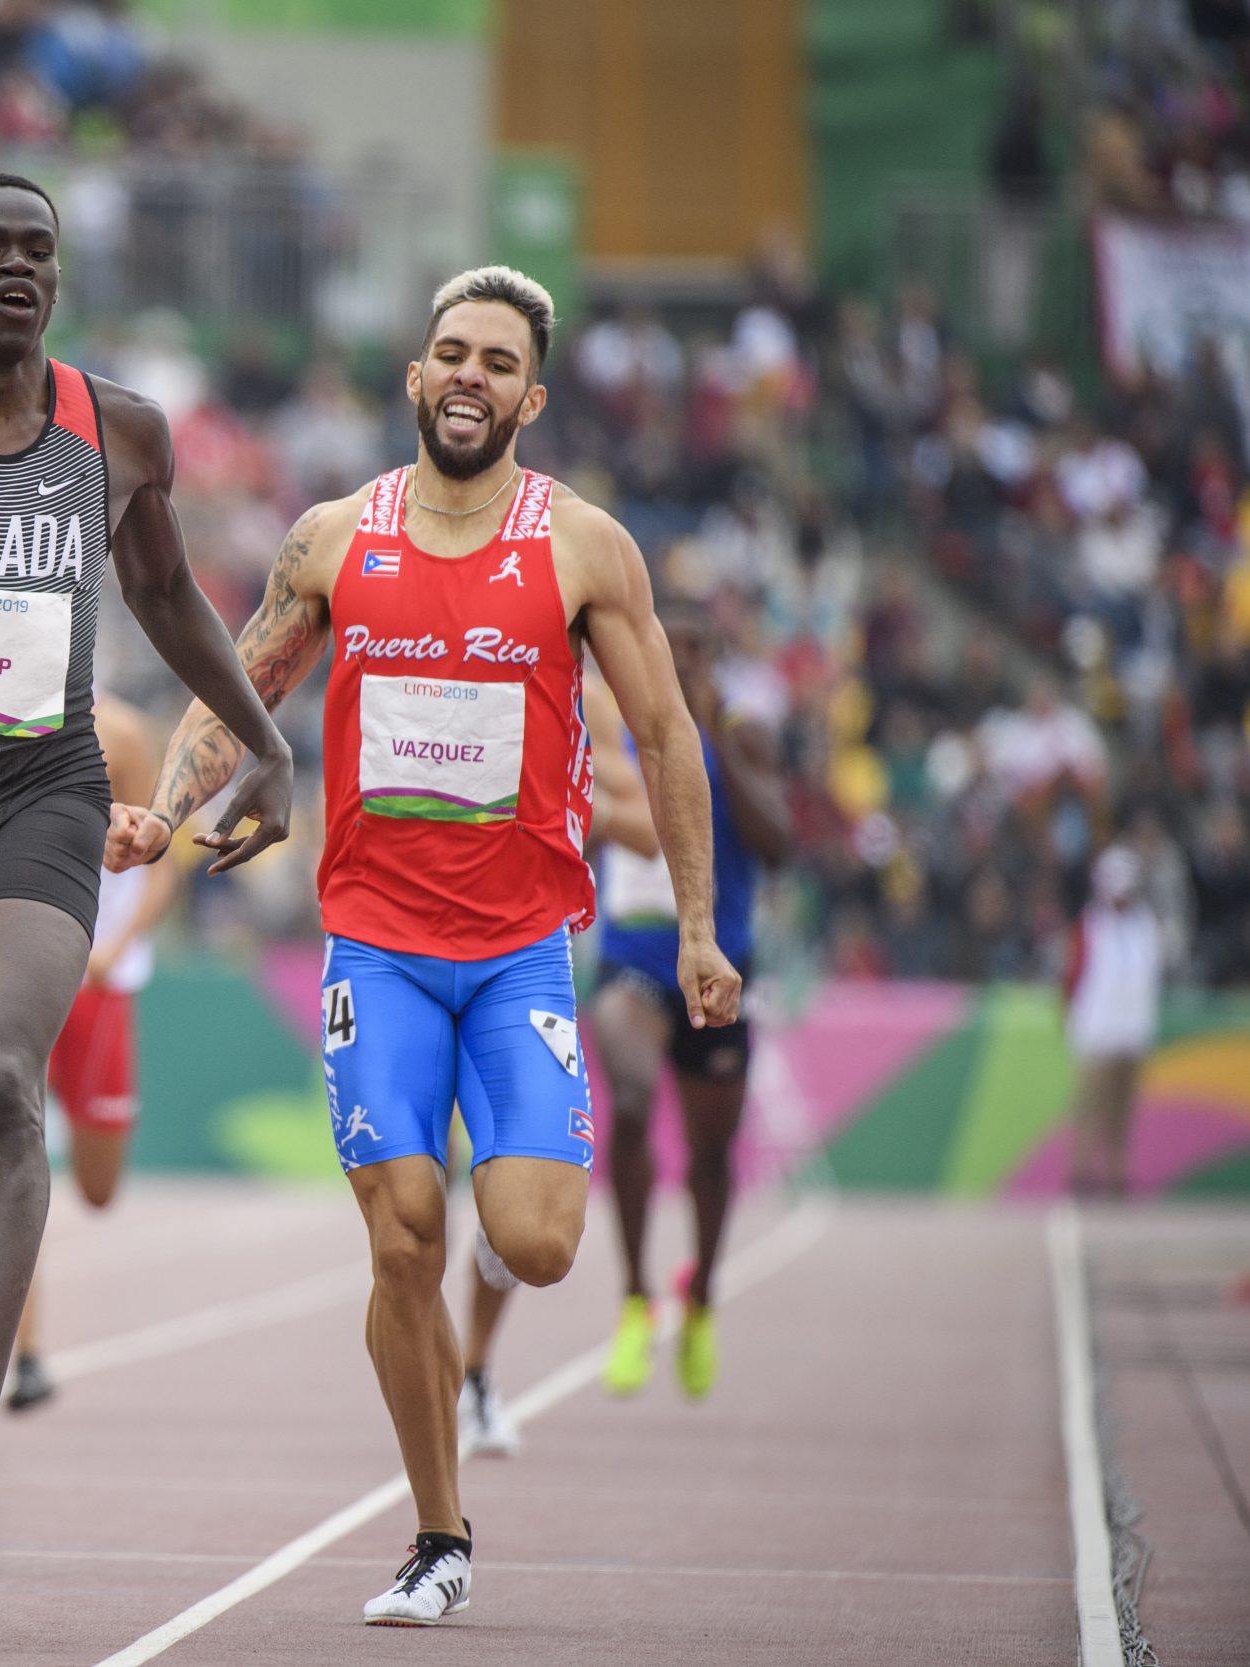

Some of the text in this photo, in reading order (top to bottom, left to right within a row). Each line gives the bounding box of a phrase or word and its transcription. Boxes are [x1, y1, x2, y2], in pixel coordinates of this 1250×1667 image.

[344, 624, 540, 665] Puerto Rico
[392, 738, 485, 765] VAZQUEZ
[327, 987, 355, 1042] 4
